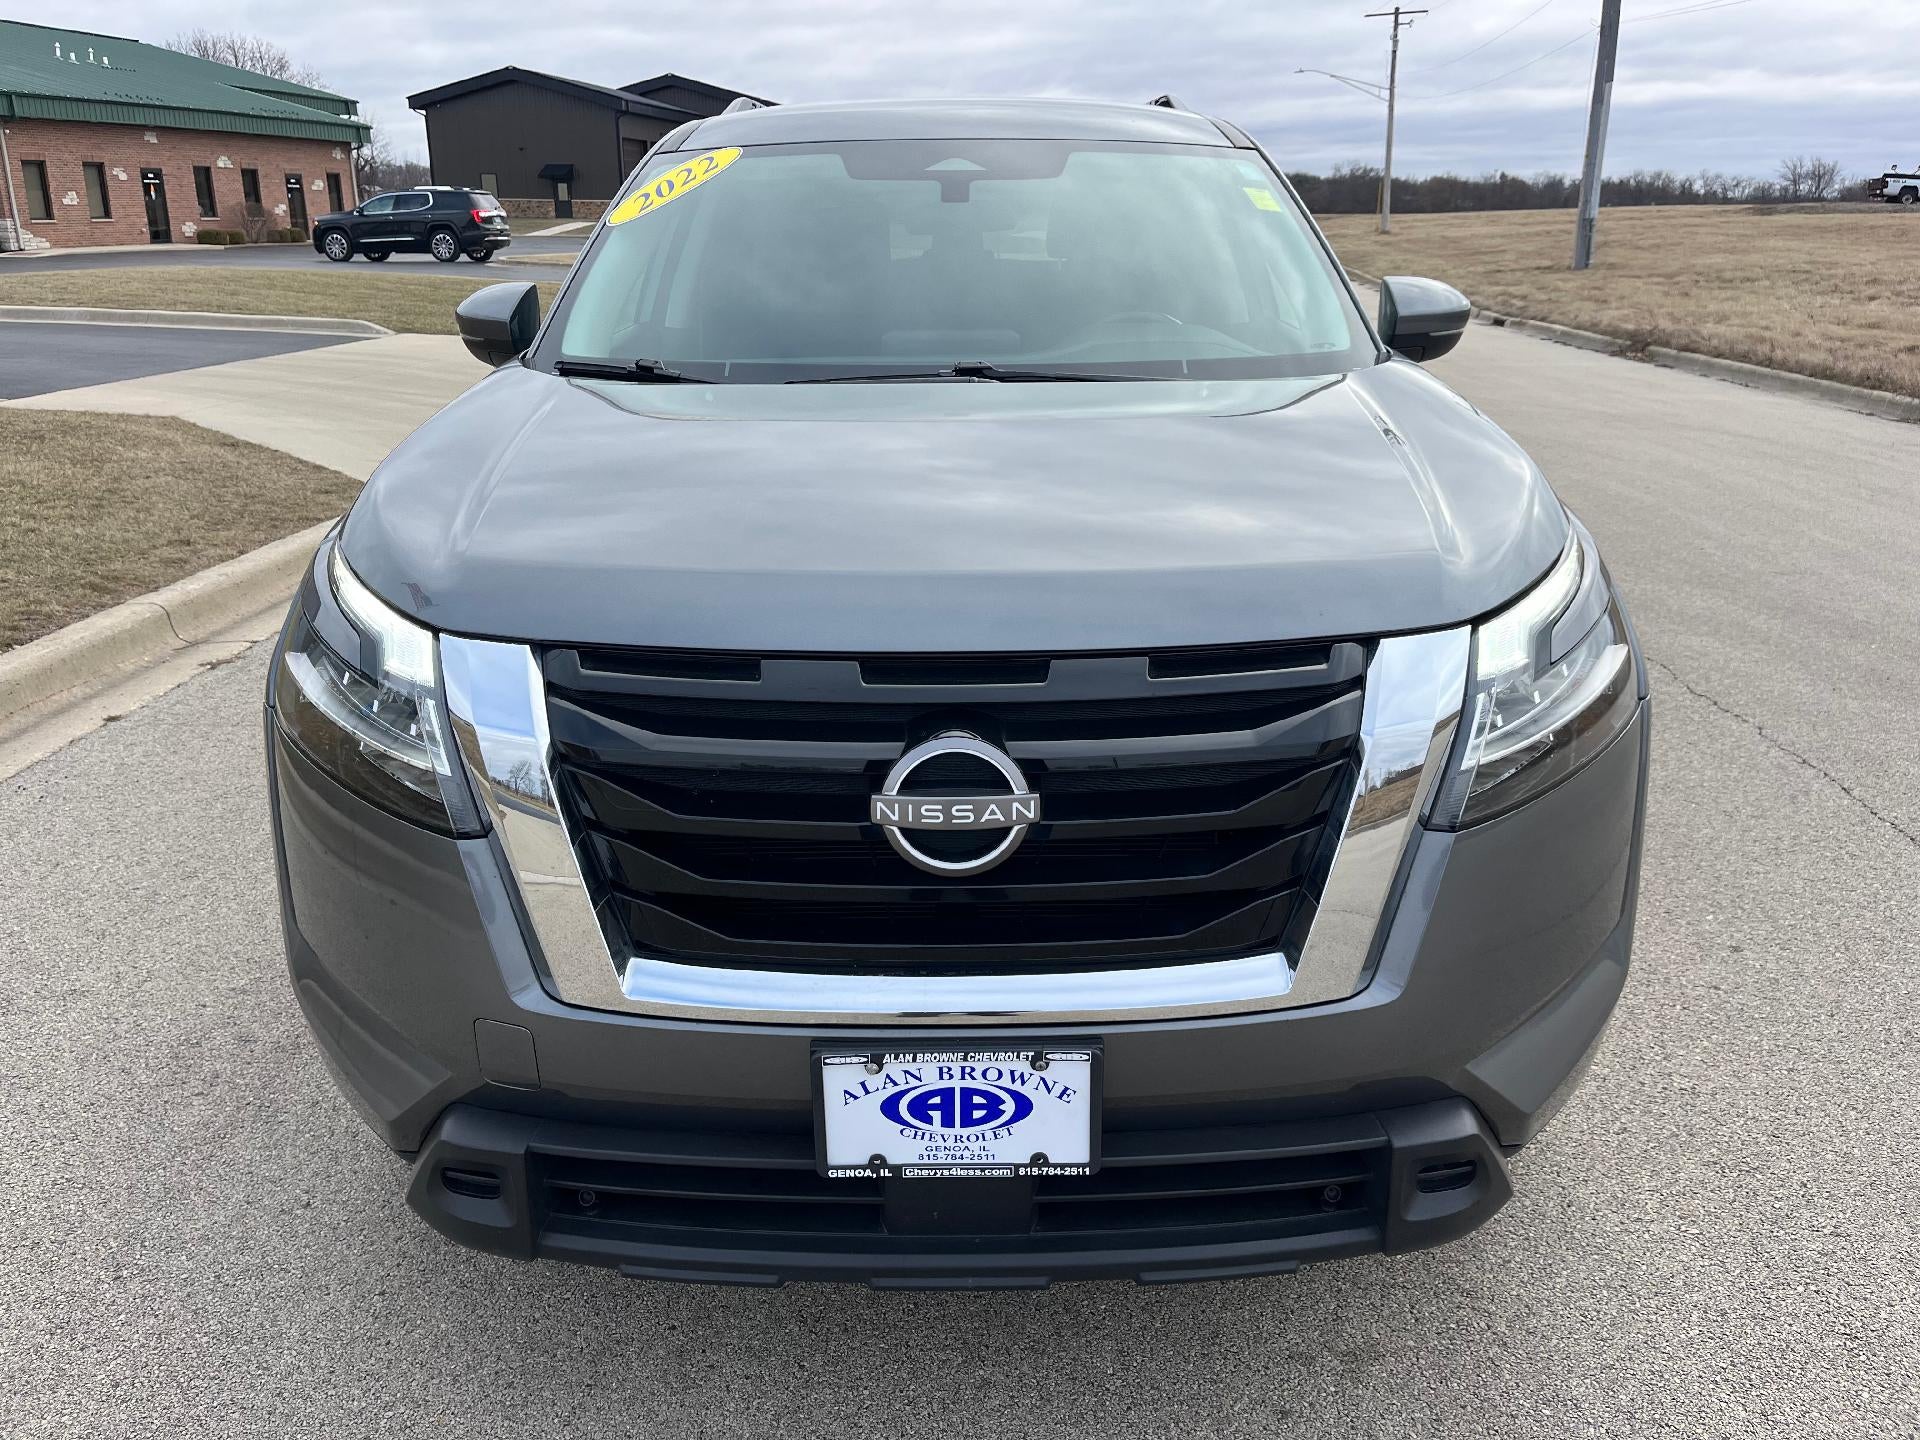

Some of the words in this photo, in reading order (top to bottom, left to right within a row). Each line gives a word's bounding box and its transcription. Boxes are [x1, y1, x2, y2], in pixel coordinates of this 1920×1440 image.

[633, 156, 719, 213] 2022
[876, 799, 1036, 824] NISSAN
[882, 1053, 914, 1063] ALAN
[916, 1052, 965, 1063] BROWNE
[967, 1051, 1035, 1062] CHEVROLET
[842, 1067, 923, 1107] ALAN
[936, 1065, 1077, 1104] BROWNE
[899, 1125, 1014, 1144] CHEVROLET
[924, 1145, 974, 1153] GENOA,
[917, 1153, 996, 1161] 815-784-2511
[827, 1169, 877, 1178] GENOA,
[879, 1168, 893, 1177] IL
[905, 1167, 1011, 1177] Chevys4less.com
[1018, 1167, 1090, 1176] 815-784-2511
